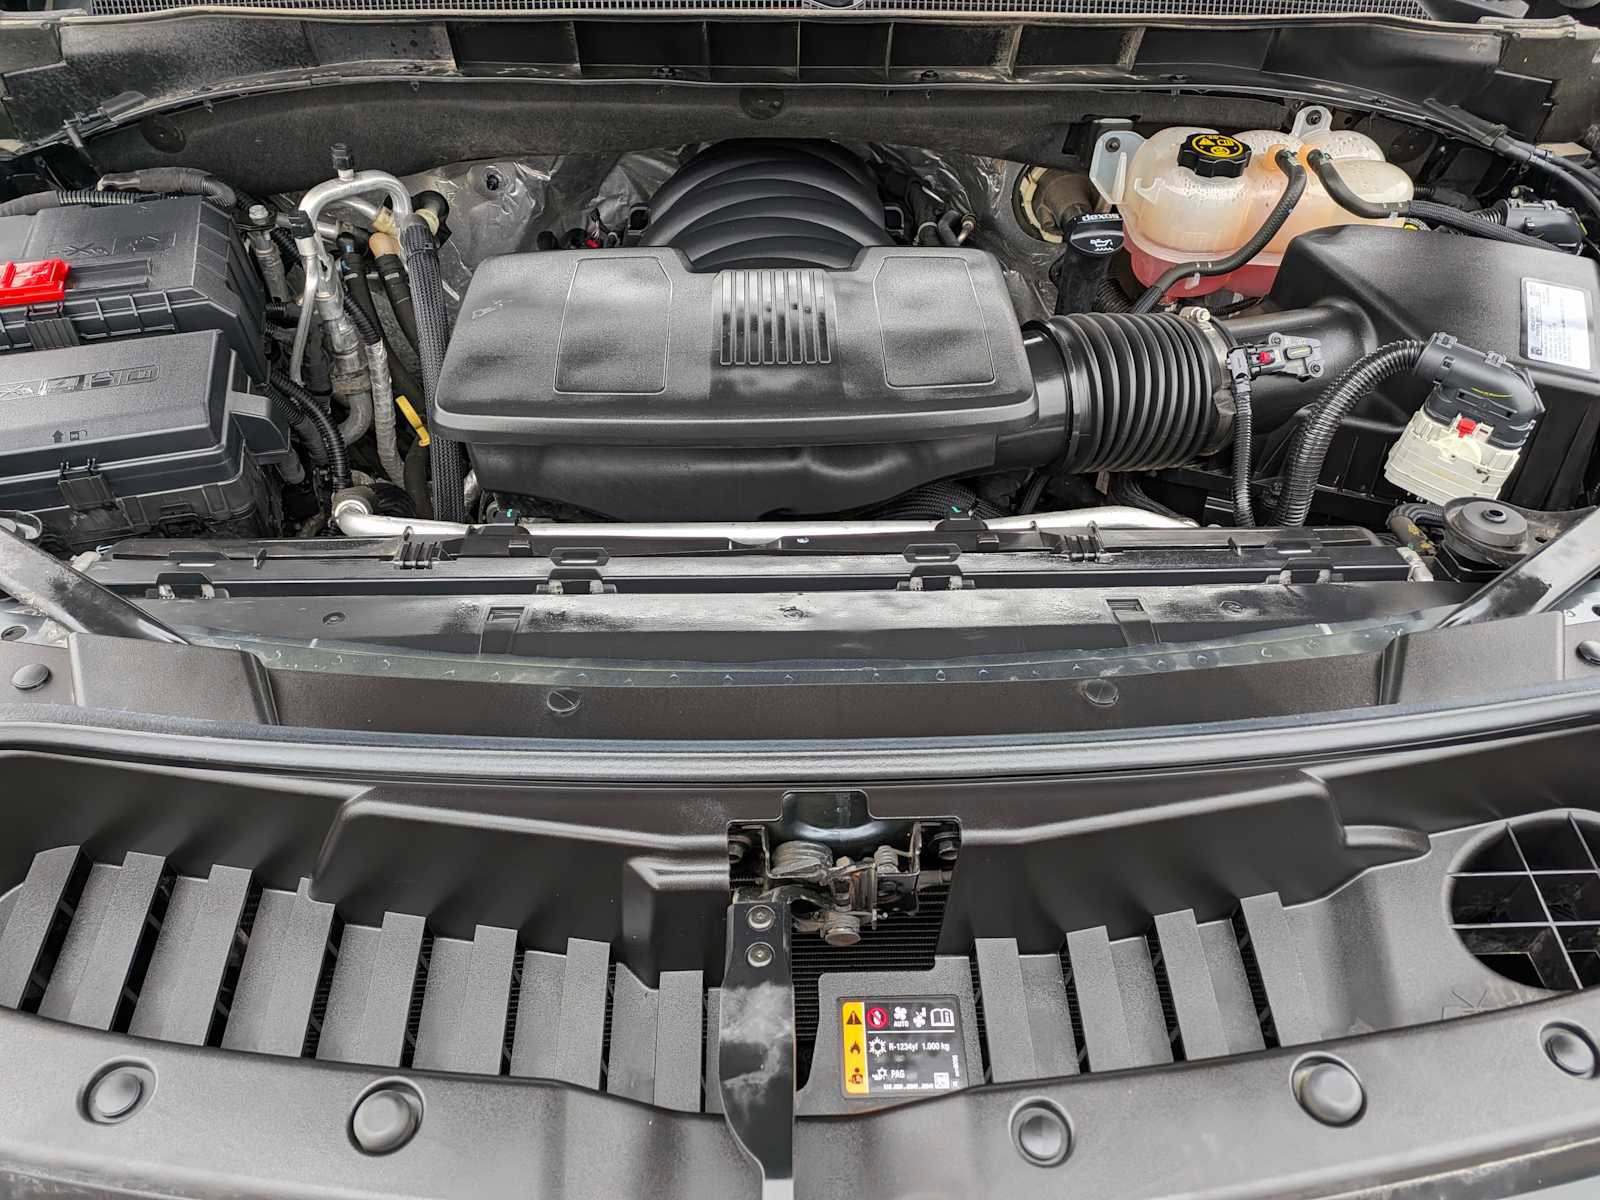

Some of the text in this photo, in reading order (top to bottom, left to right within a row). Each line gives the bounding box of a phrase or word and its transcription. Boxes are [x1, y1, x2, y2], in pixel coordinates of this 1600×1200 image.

[1081, 213, 1120, 221] dexos
[921, 1042, 940, 1050] 1.000
[940, 1042, 950, 1052] kg
[890, 1069, 905, 1078] PAG
